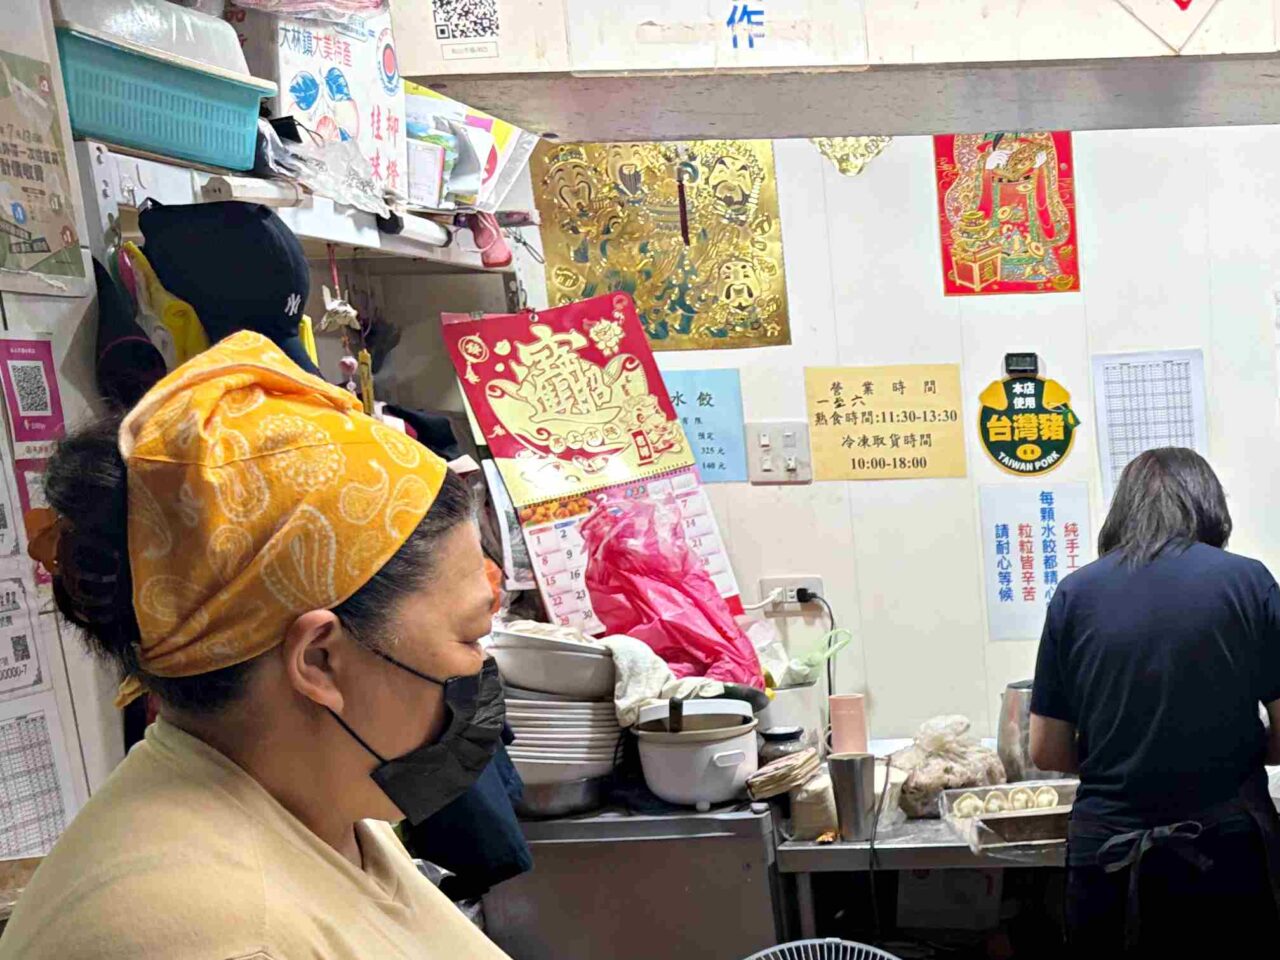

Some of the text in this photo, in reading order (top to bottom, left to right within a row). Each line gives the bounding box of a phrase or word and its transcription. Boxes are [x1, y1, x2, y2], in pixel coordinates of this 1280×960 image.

[830, 380, 937, 396] 營業時間
[1012, 382, 1035, 395] 本店
[1013, 396, 1036, 409] 使用
[814, 410, 958, 426] 熟食時間:11:30-13:30
[986, 413, 1065, 442] 台灣豬
[841, 433, 933, 449] 冷凍取貨時間
[851, 457, 927, 470] 10:00-18:00
[997, 450, 1061, 471] TAIWAN PORK
[560, 529, 567, 539] 2
[1039, 490, 1059, 607] 每顆水餃都精心
[1064, 522, 1080, 574] 純手工
[541, 557, 548, 567] 8
[566, 549, 573, 560] 9
[994, 523, 1013, 602] 請耐心等候
[1017, 523, 1036, 602] 粒粒皆辛苦
[545, 577, 557, 586] 15
[569, 569, 581, 580] 16
[552, 590, 586, 607] 22 23
[582, 609, 593, 620] 30
